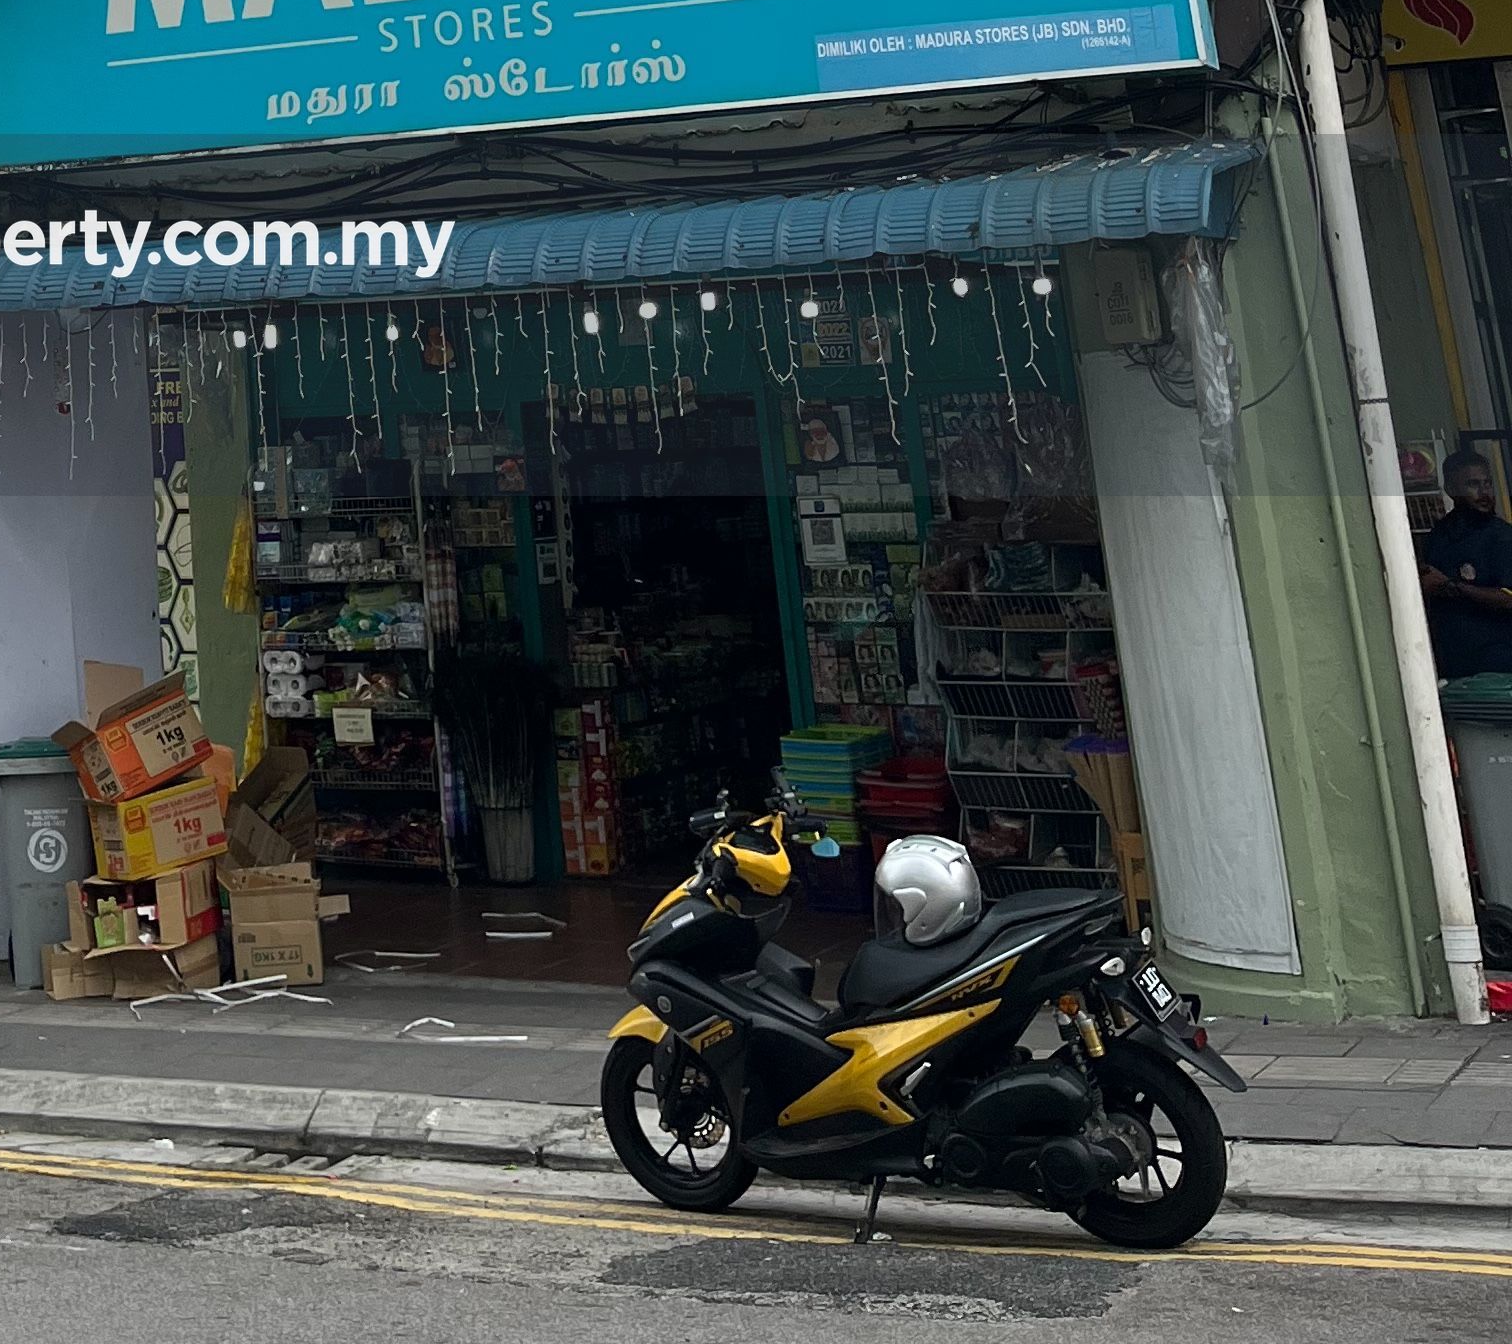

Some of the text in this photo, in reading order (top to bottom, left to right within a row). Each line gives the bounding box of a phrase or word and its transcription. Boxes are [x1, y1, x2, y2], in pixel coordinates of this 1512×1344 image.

[378, 0, 554, 55] STORES
[817, 39, 866, 59] DIMILIKI
[870, 37, 905, 54] OLEH
[915, 30, 973, 49] MADURA
[975, 25, 1029, 44] STORES
[1031, 21, 1059, 43] (JB)
[1061, 19, 1094, 37] SDN.
[1096, 17, 1131, 34] BHD.
[267, 78, 401, 126] மதுரா
[823, 345, 852, 359] 2021
[156, 381, 182, 394] FRE
[156, 726, 184, 746] 1kg
[174, 817, 202, 834] 1kg
